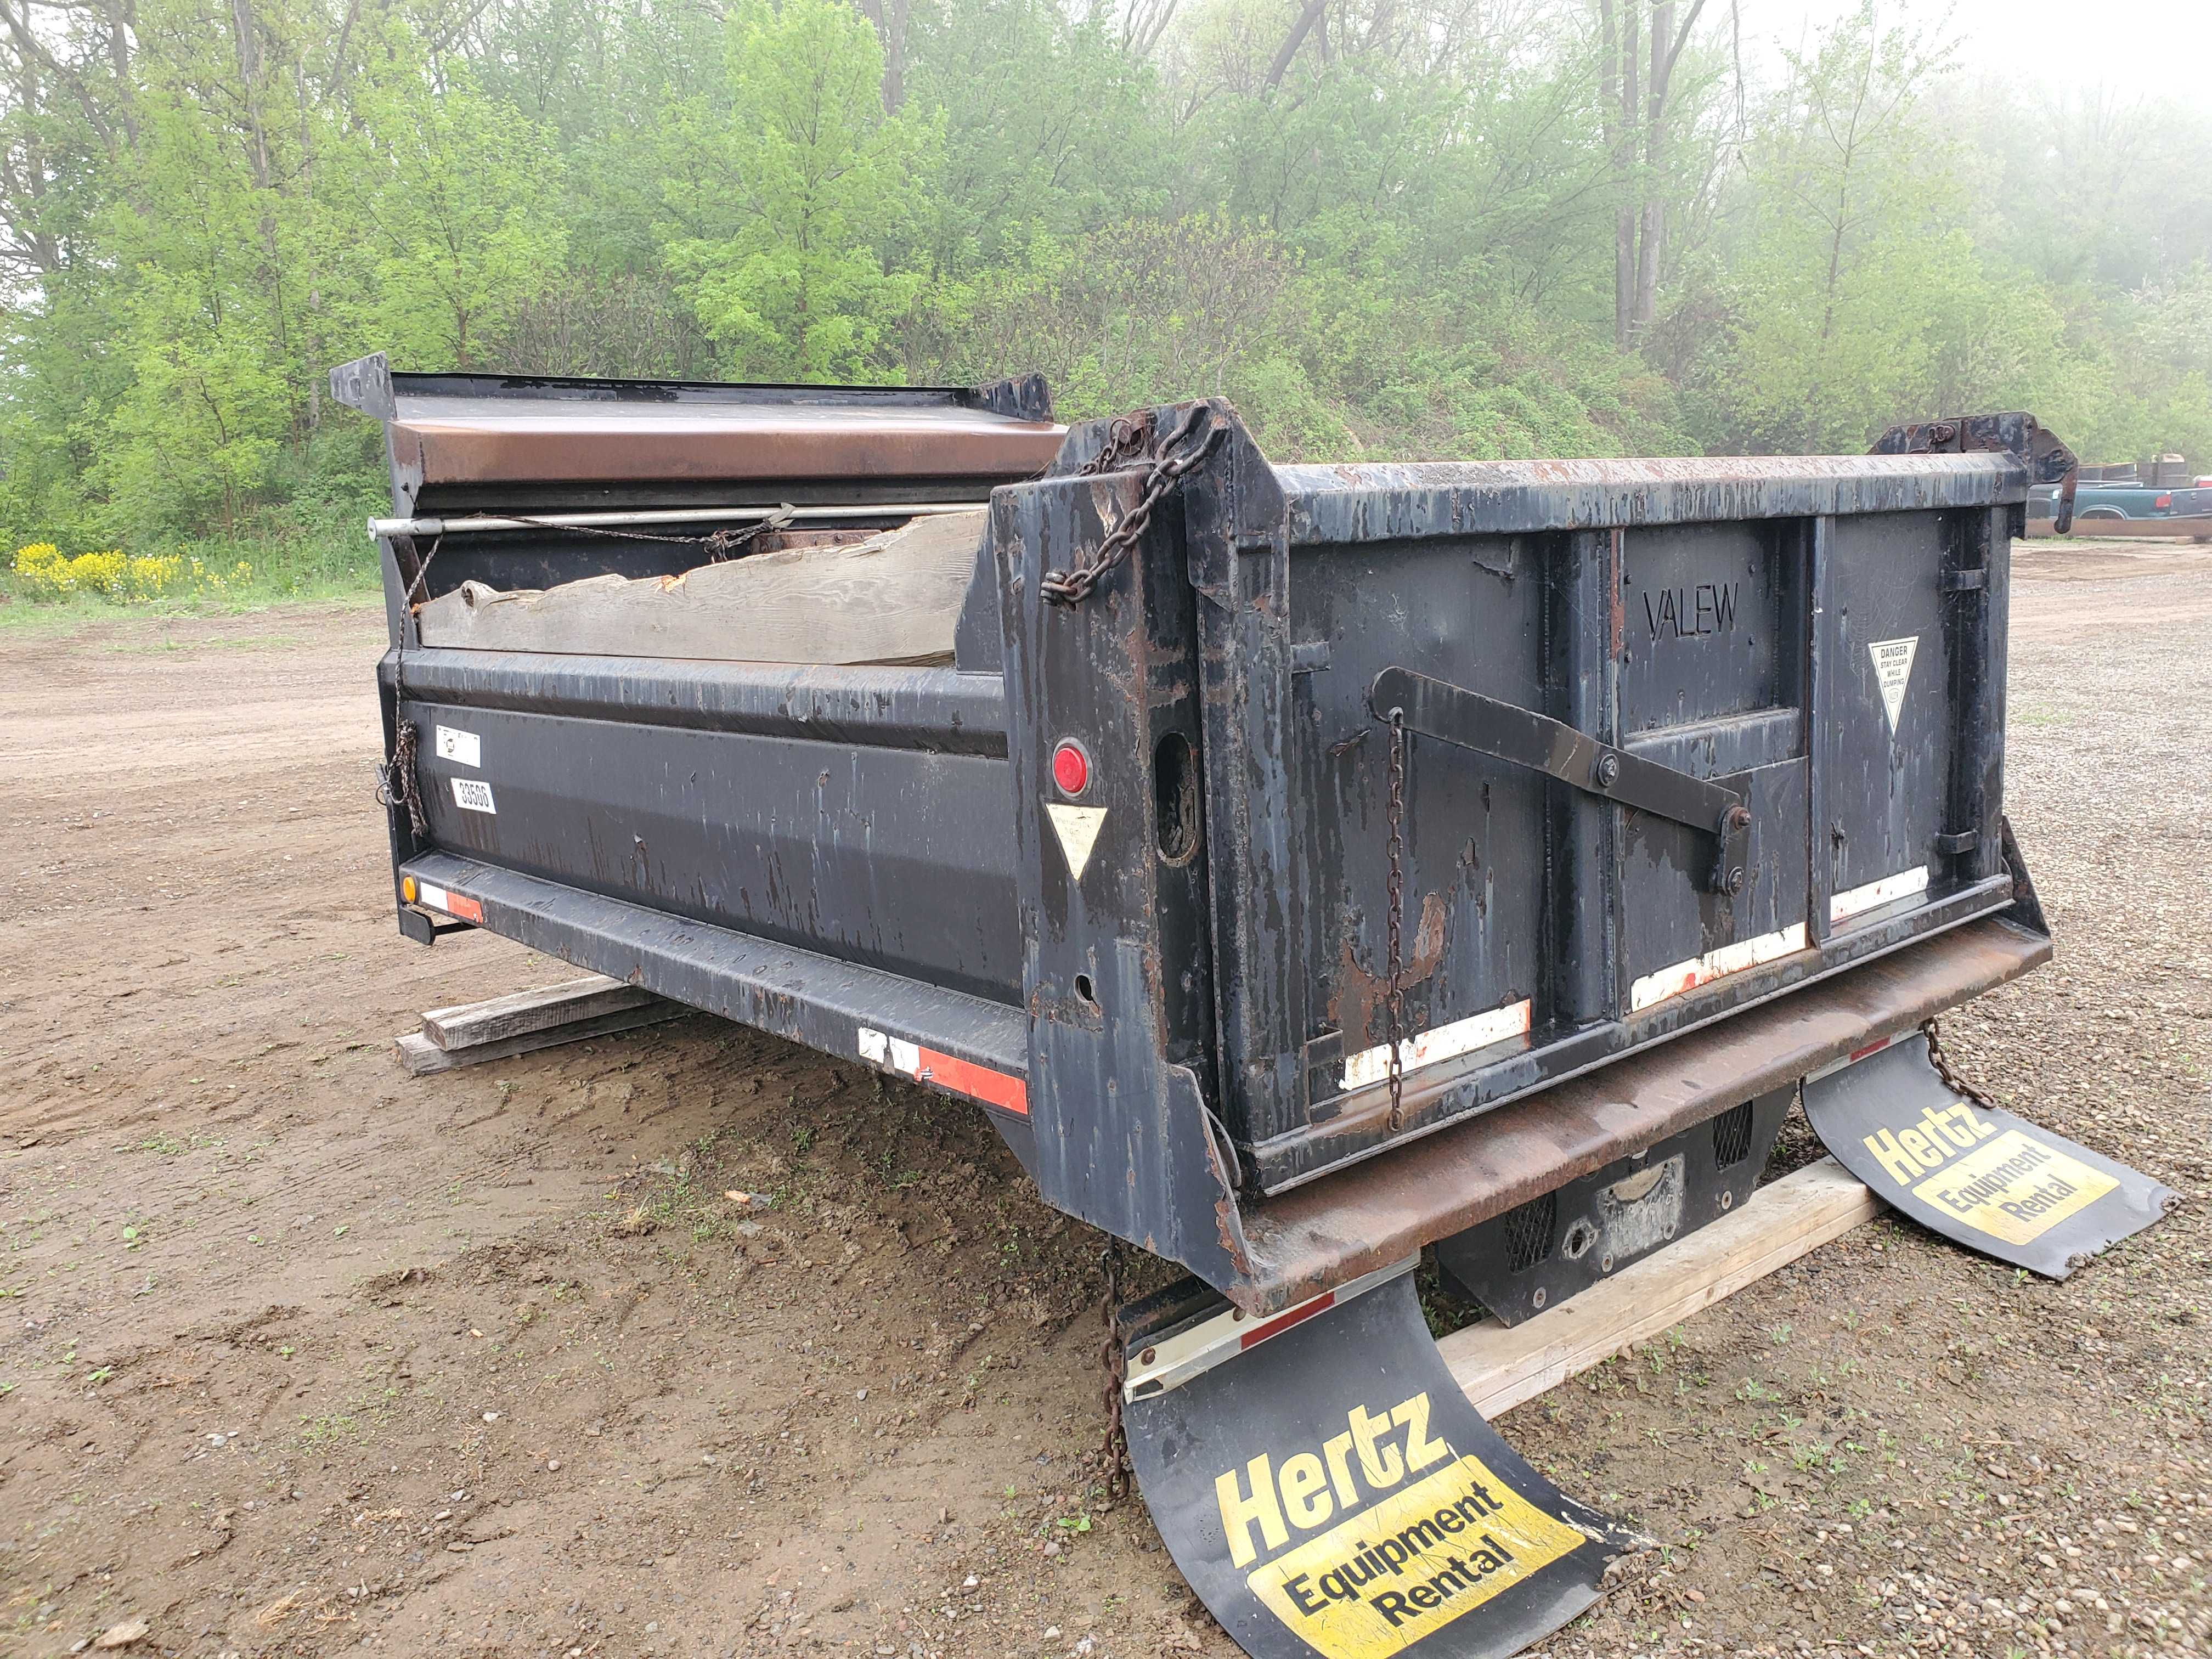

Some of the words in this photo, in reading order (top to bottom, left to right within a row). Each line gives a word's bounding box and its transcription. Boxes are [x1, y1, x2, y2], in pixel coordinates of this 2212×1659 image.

[1642, 582, 1738, 641] VALEW
[1880, 661, 1892, 669] STAY
[1893, 658, 1908, 667] CLEAR
[1881, 645, 1908, 658] DANGER
[1887, 668, 1901, 678] WHILE
[1883, 678, 1904, 688] DUMPING
[1863, 1102, 1997, 1186] Hertz
[1937, 1142, 2055, 1212] Equipment
[1999, 1173, 2078, 1222] Rental
[1215, 1391, 1449, 1569] Hertz
[1282, 1480, 1504, 1617] Equipment
[1371, 1534, 1514, 1627] Rental
